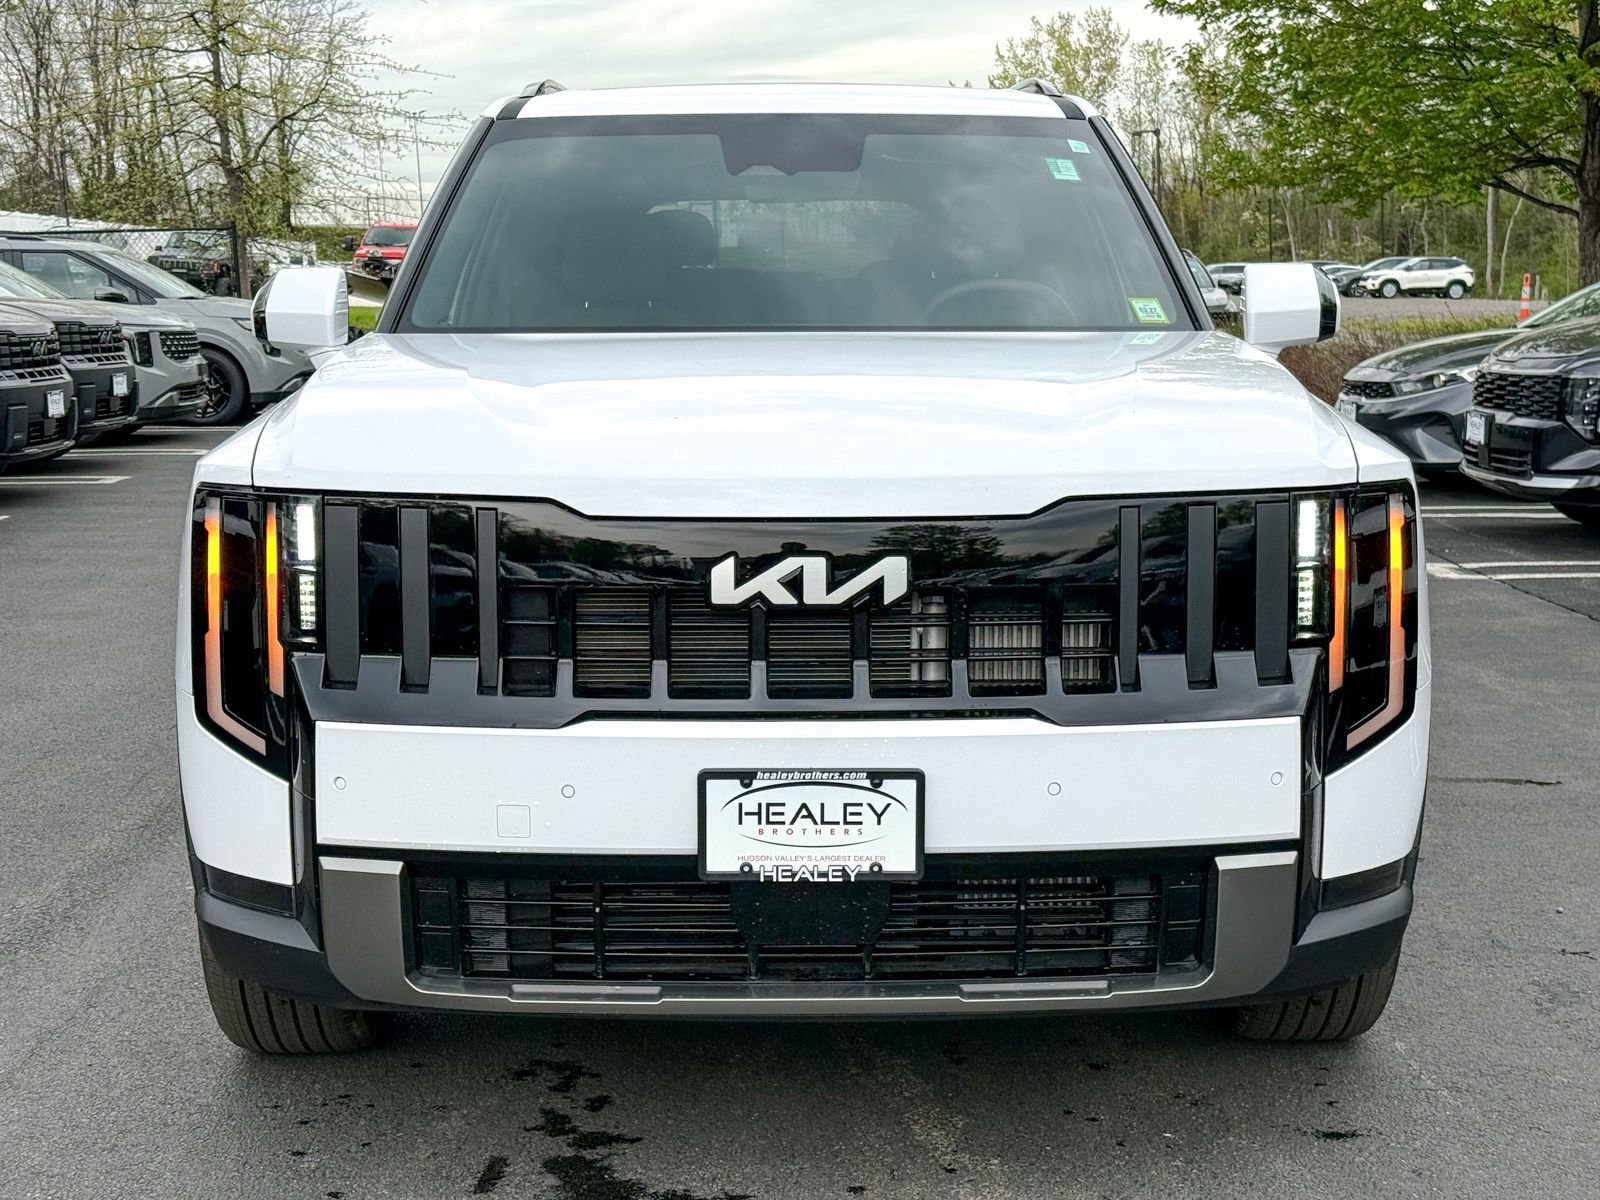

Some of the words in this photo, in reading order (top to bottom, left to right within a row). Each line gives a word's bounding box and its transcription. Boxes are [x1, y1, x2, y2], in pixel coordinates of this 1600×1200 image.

[711, 556, 908, 605] KIA
[756, 771, 867, 780] healeybrothers.com
[738, 802, 892, 826] HEALEY
[758, 828, 863, 836] BROTHERS
[759, 865, 862, 882] HEALEY
